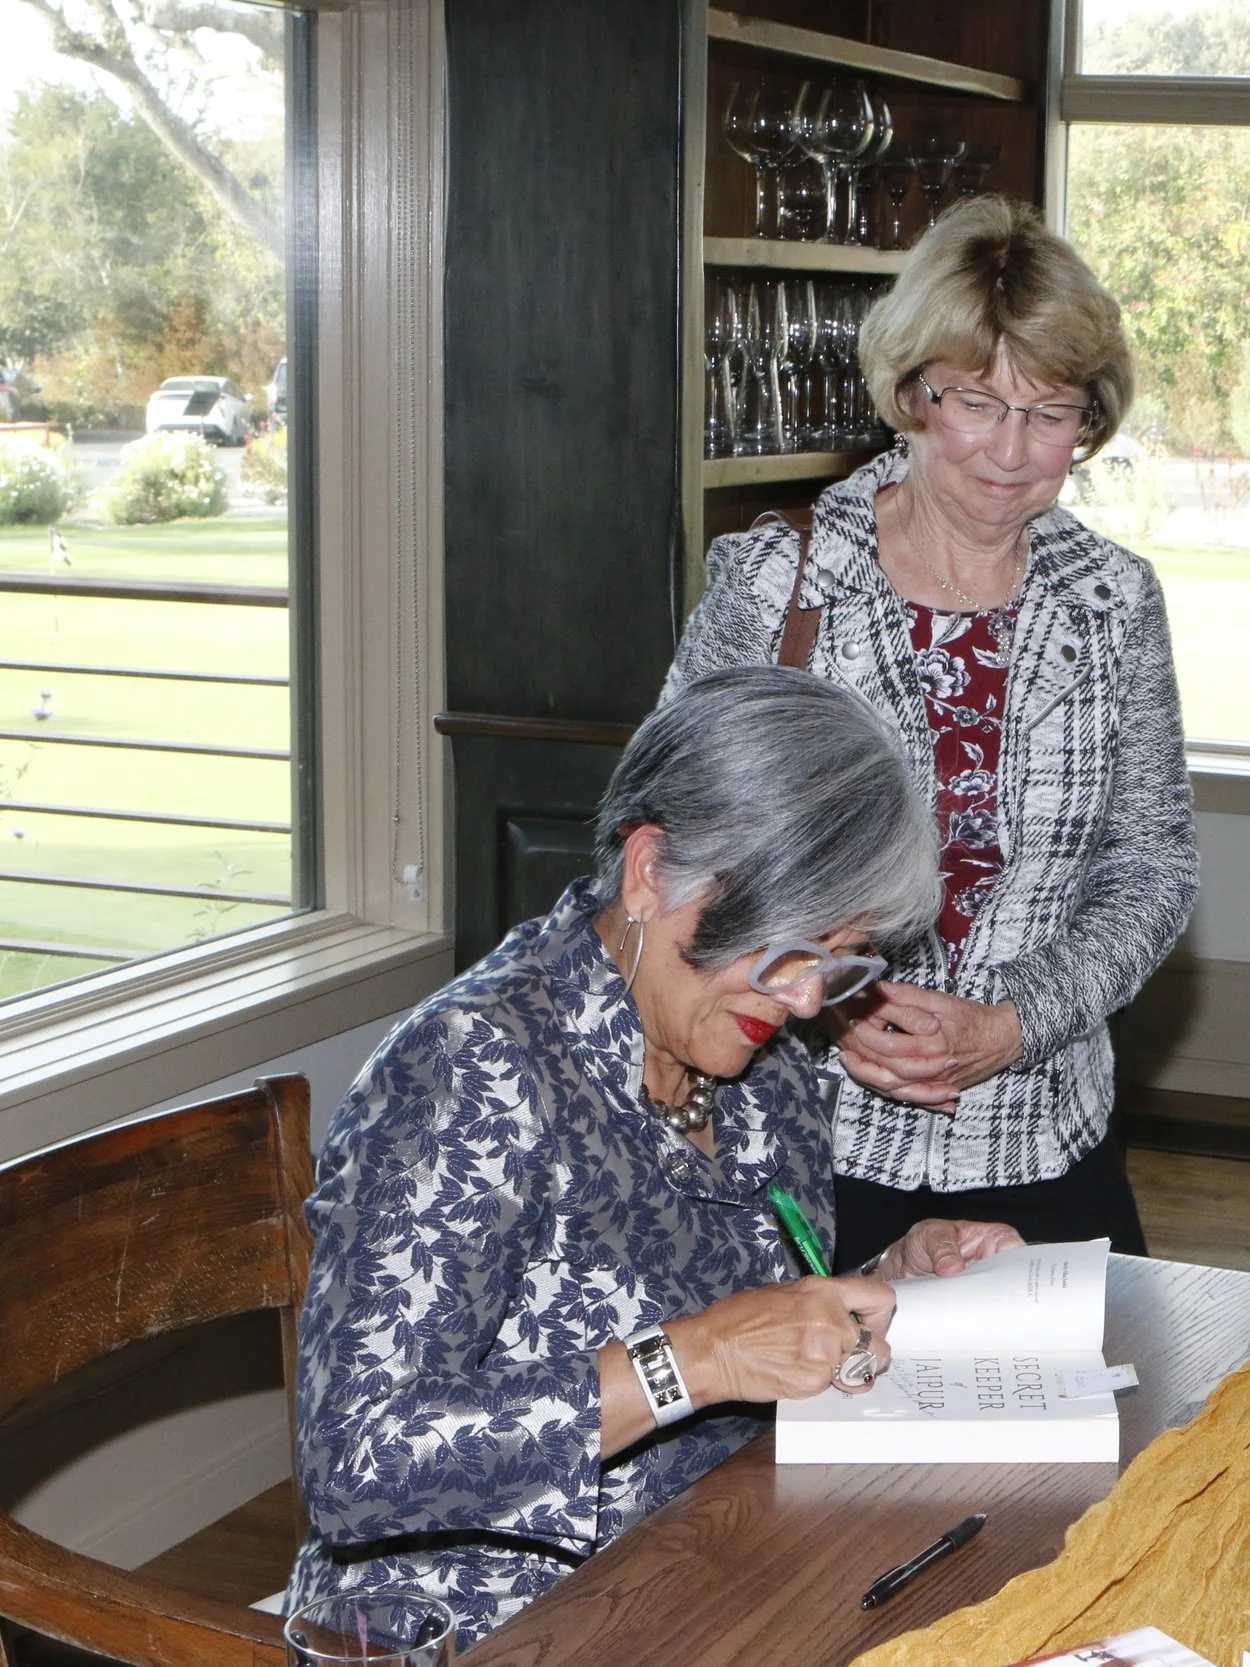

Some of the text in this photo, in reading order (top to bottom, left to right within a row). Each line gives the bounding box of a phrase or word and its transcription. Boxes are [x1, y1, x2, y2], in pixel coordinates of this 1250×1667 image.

[909, 1357, 945, 1411] JAIPUR
[973, 1357, 1005, 1411] KEEPER
[1012, 1357, 1047, 1411] SECRET
